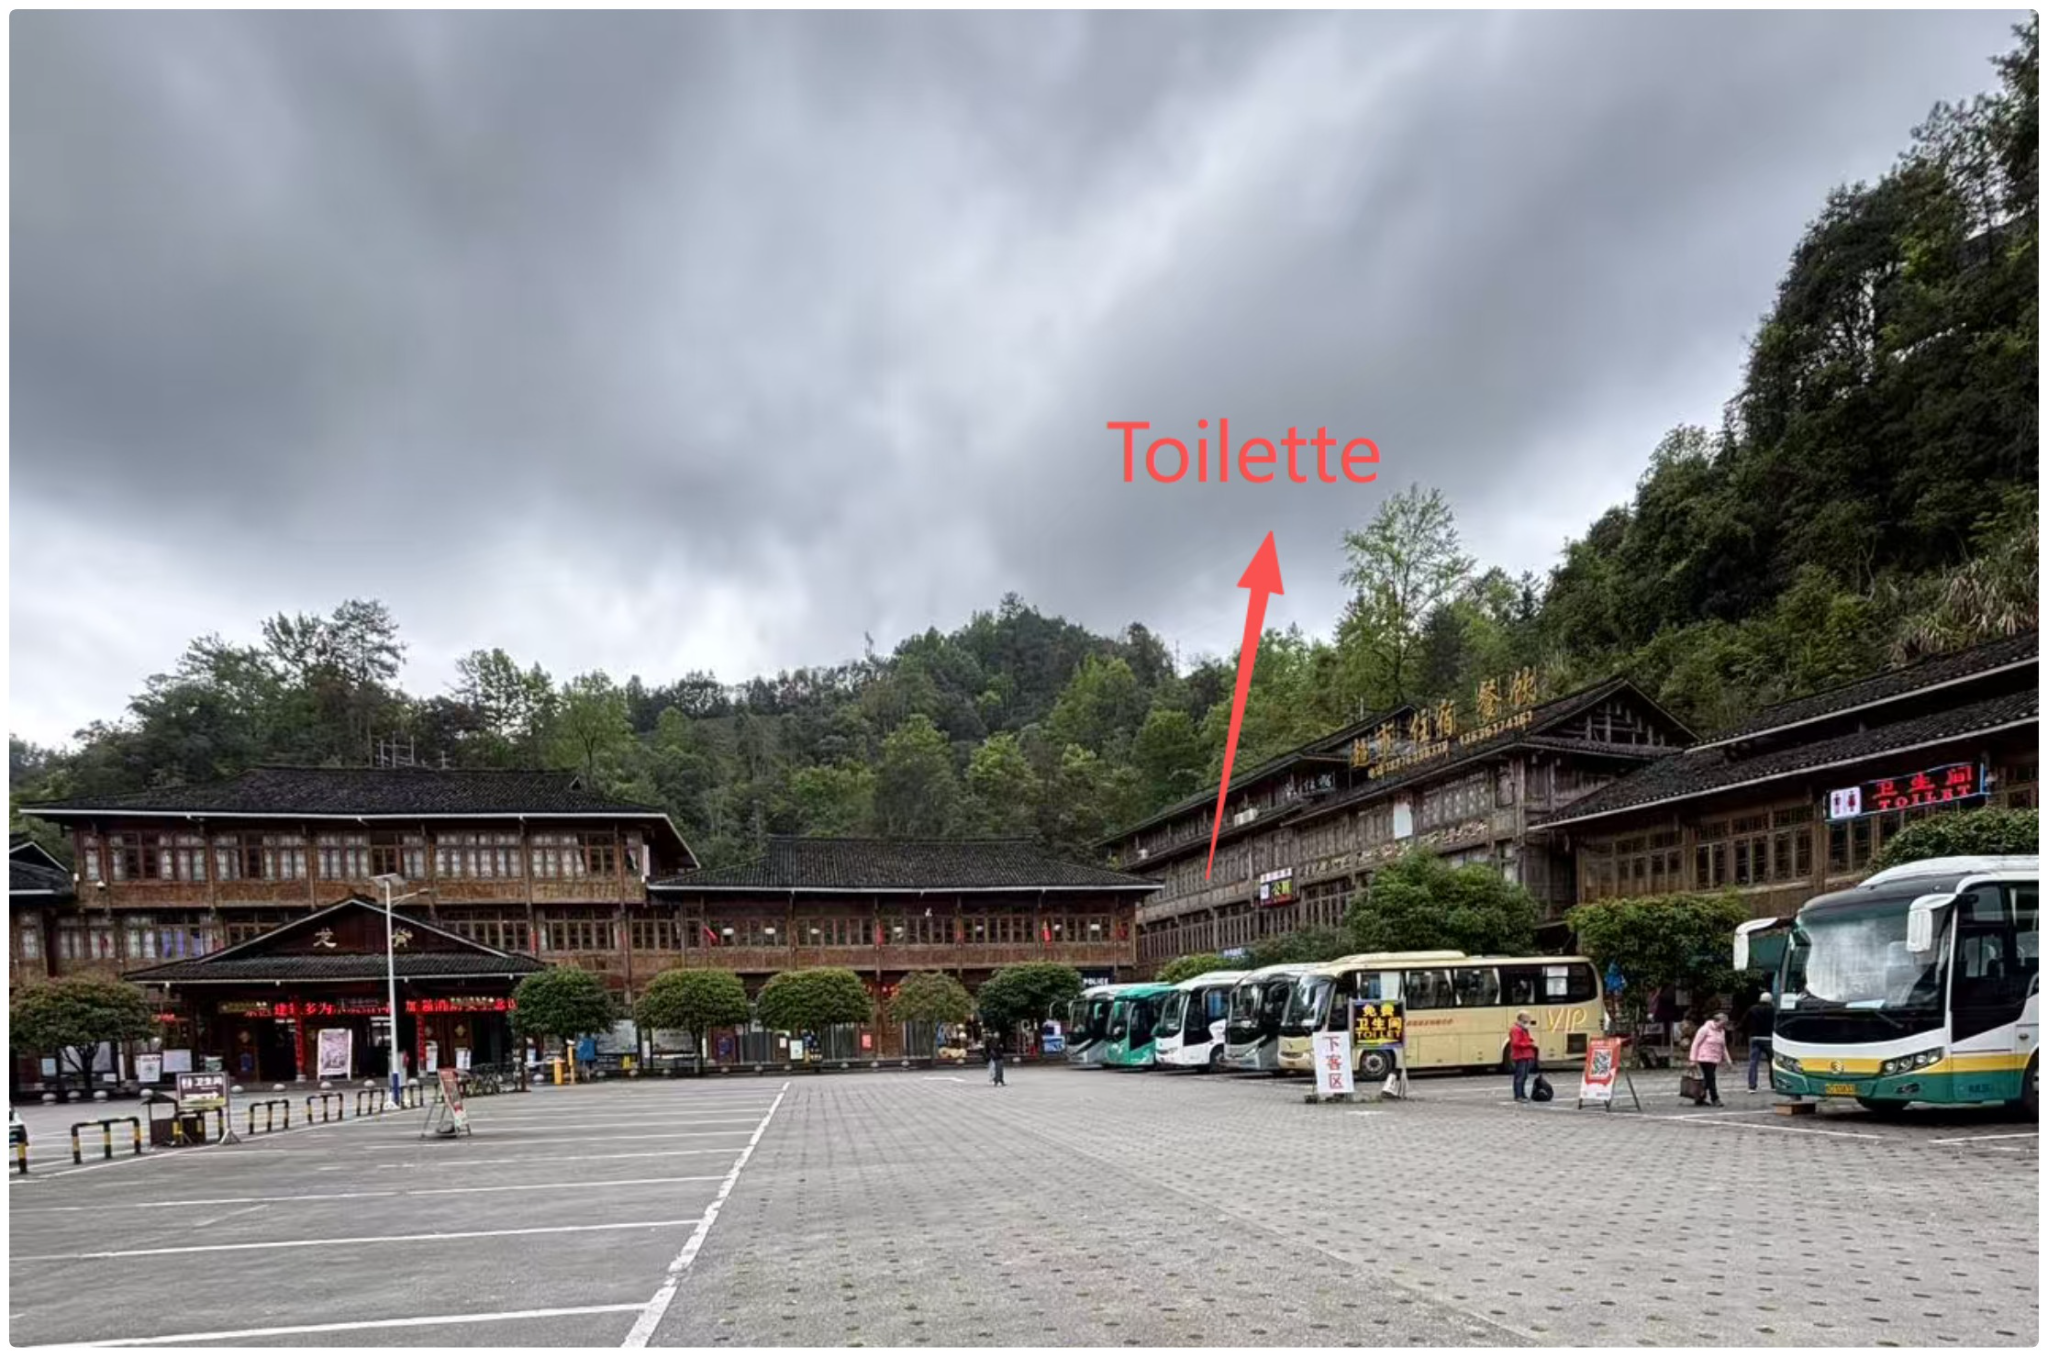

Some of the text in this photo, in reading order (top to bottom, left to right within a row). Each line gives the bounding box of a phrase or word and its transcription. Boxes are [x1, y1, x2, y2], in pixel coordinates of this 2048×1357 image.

[1410, 699, 1456, 745] 住宿
[1872, 766, 1972, 799] 卫生间
[1878, 784, 1972, 812] TOILET
[1083, 976, 1109, 986] POLICE
[1361, 1003, 1395, 1017] 免费
[1546, 1008, 1587, 1033] VIP
[1355, 1017, 1403, 1032] 卫生间
[1356, 1029, 1402, 1039] TOILET
[1322, 1036, 1343, 1089] 下客区
